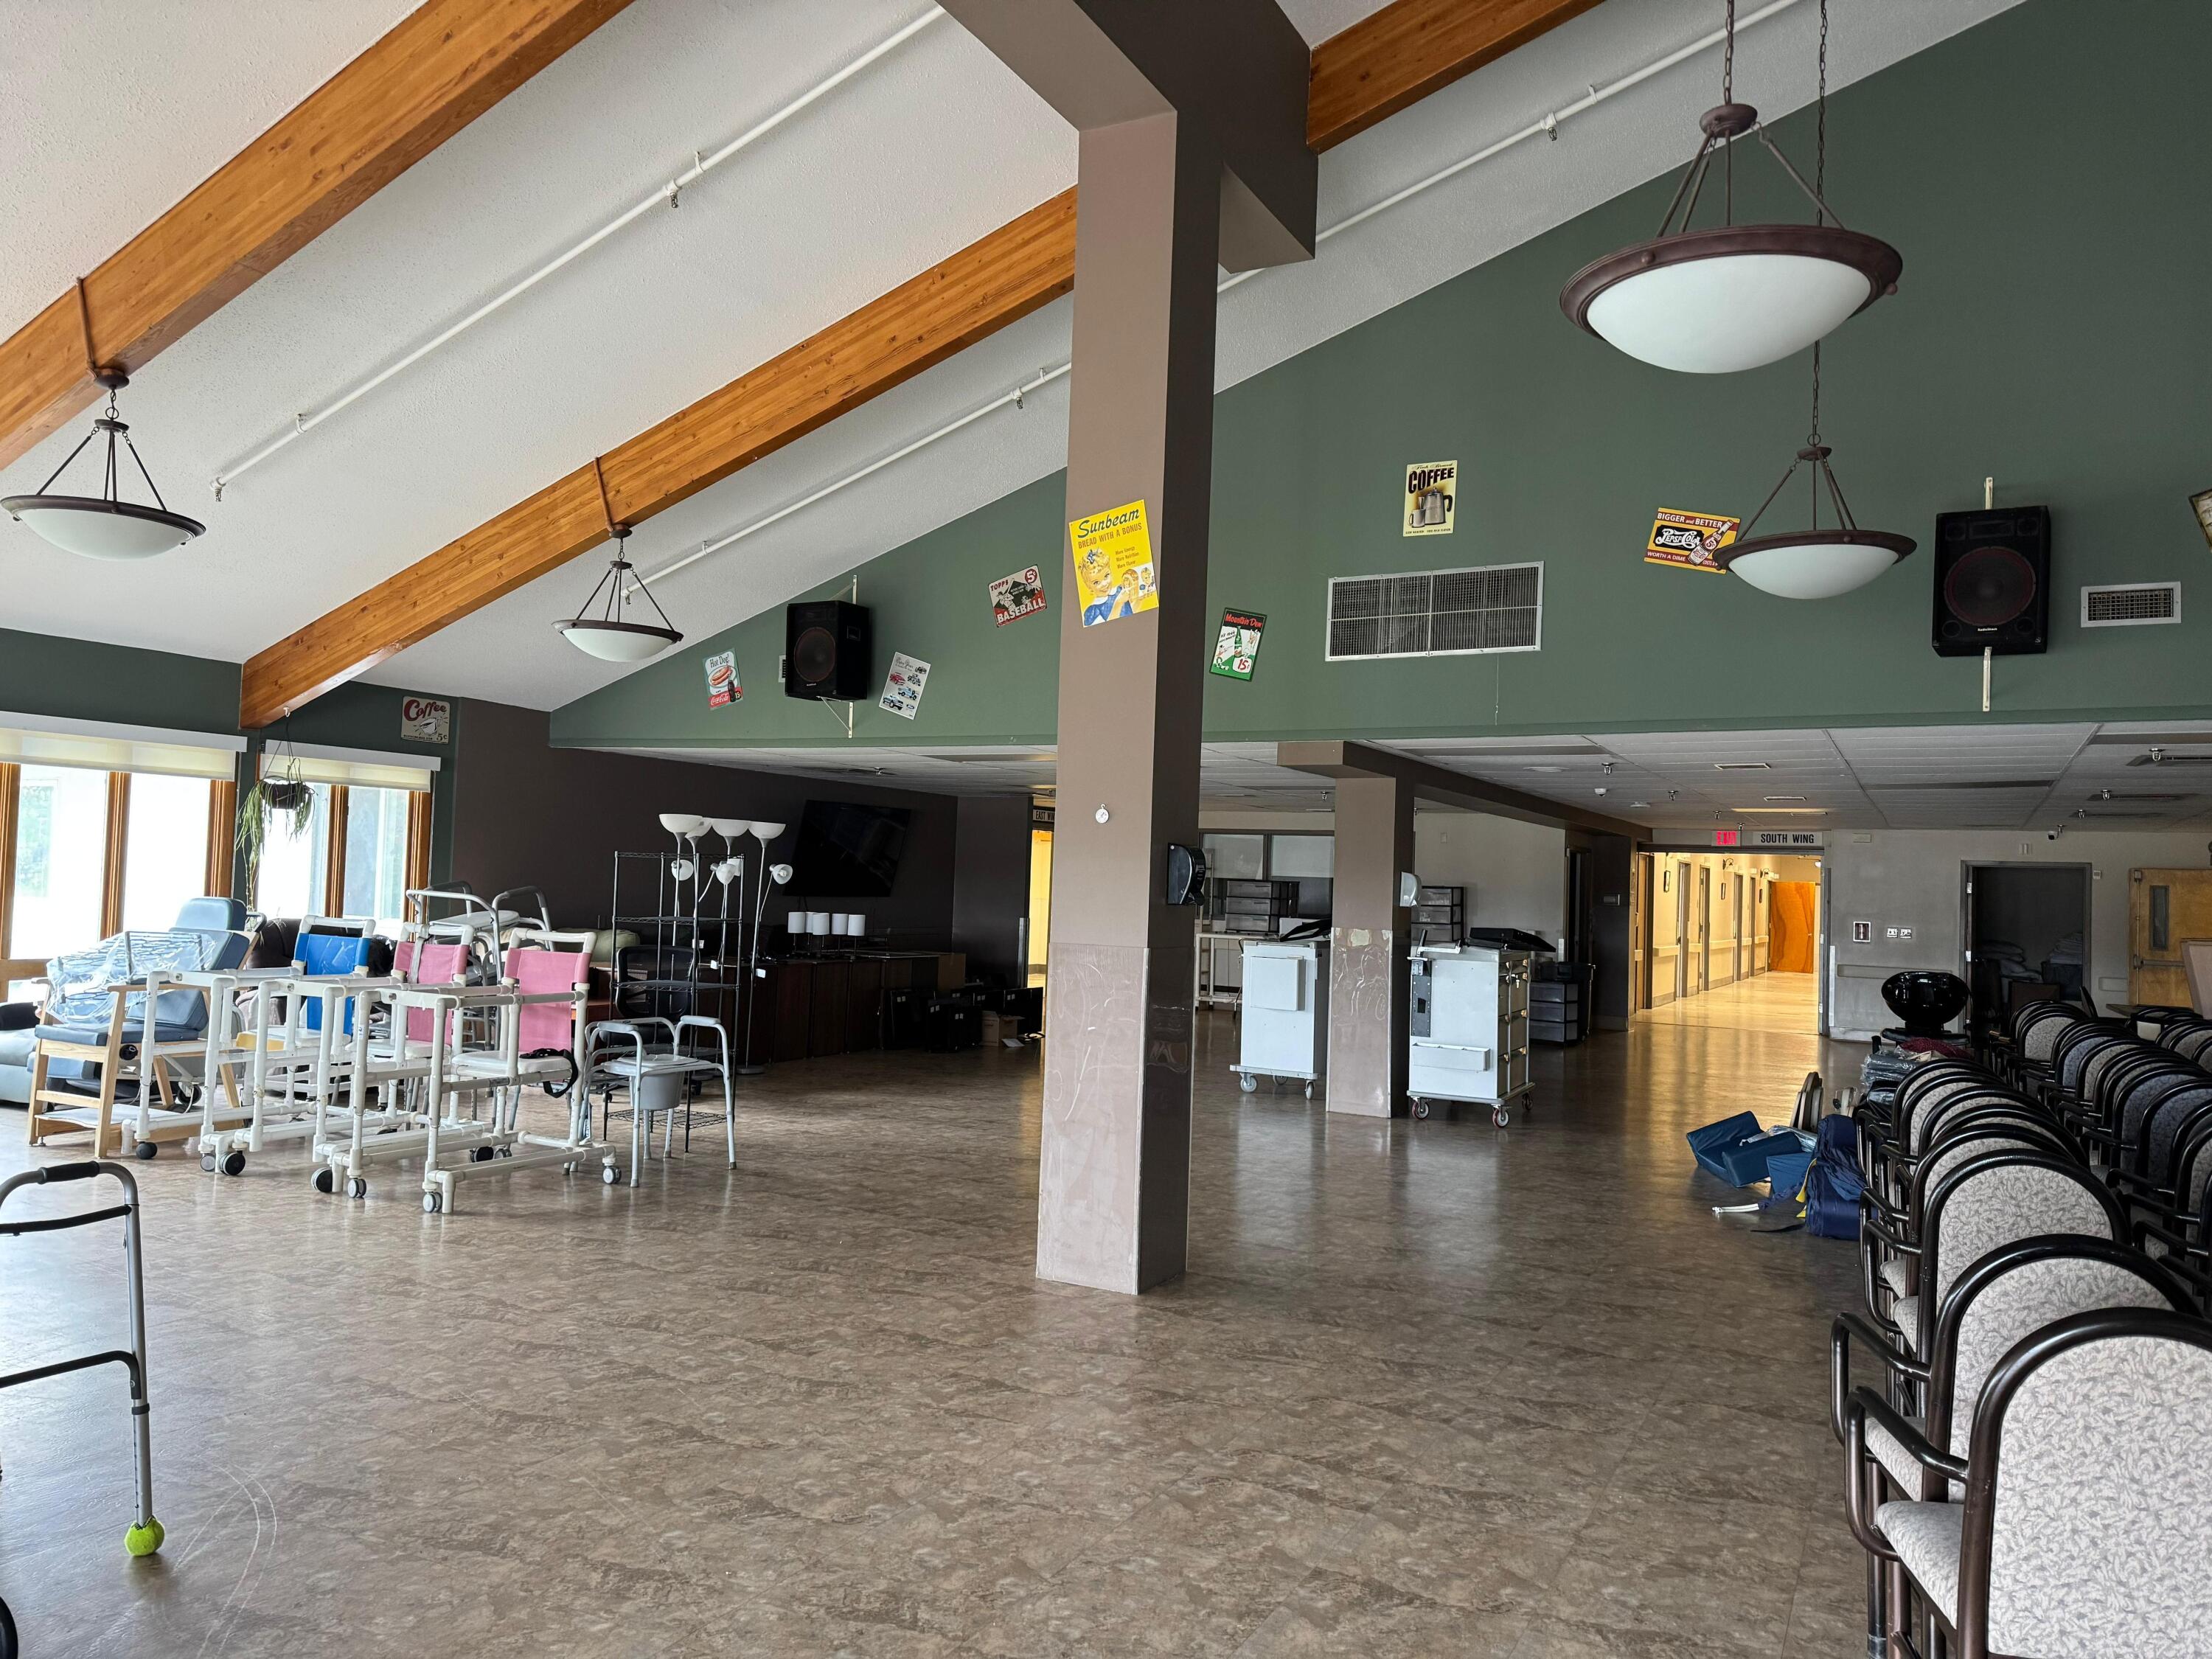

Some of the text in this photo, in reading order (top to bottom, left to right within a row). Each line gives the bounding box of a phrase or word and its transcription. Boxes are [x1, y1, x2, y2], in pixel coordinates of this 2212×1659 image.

[1408, 467, 1454, 494] COFFEE
[1077, 508, 1140, 538] Sunbeam
[1657, 512, 1686, 523] BIGGER
[1694, 518, 1722, 528] BETTER
[1078, 522, 1142, 549] BREAD WITH A BONUS
[990, 580, 1009, 591] TOPPS
[997, 598, 1046, 623] BASEBALL
[710, 658, 719, 668] Hot
[403, 699, 447, 721] Coffee
[1035, 810, 1046, 820] EAST
[1716, 830, 1737, 846] EXIT
[1761, 833, 1815, 844] SOUTH WING
